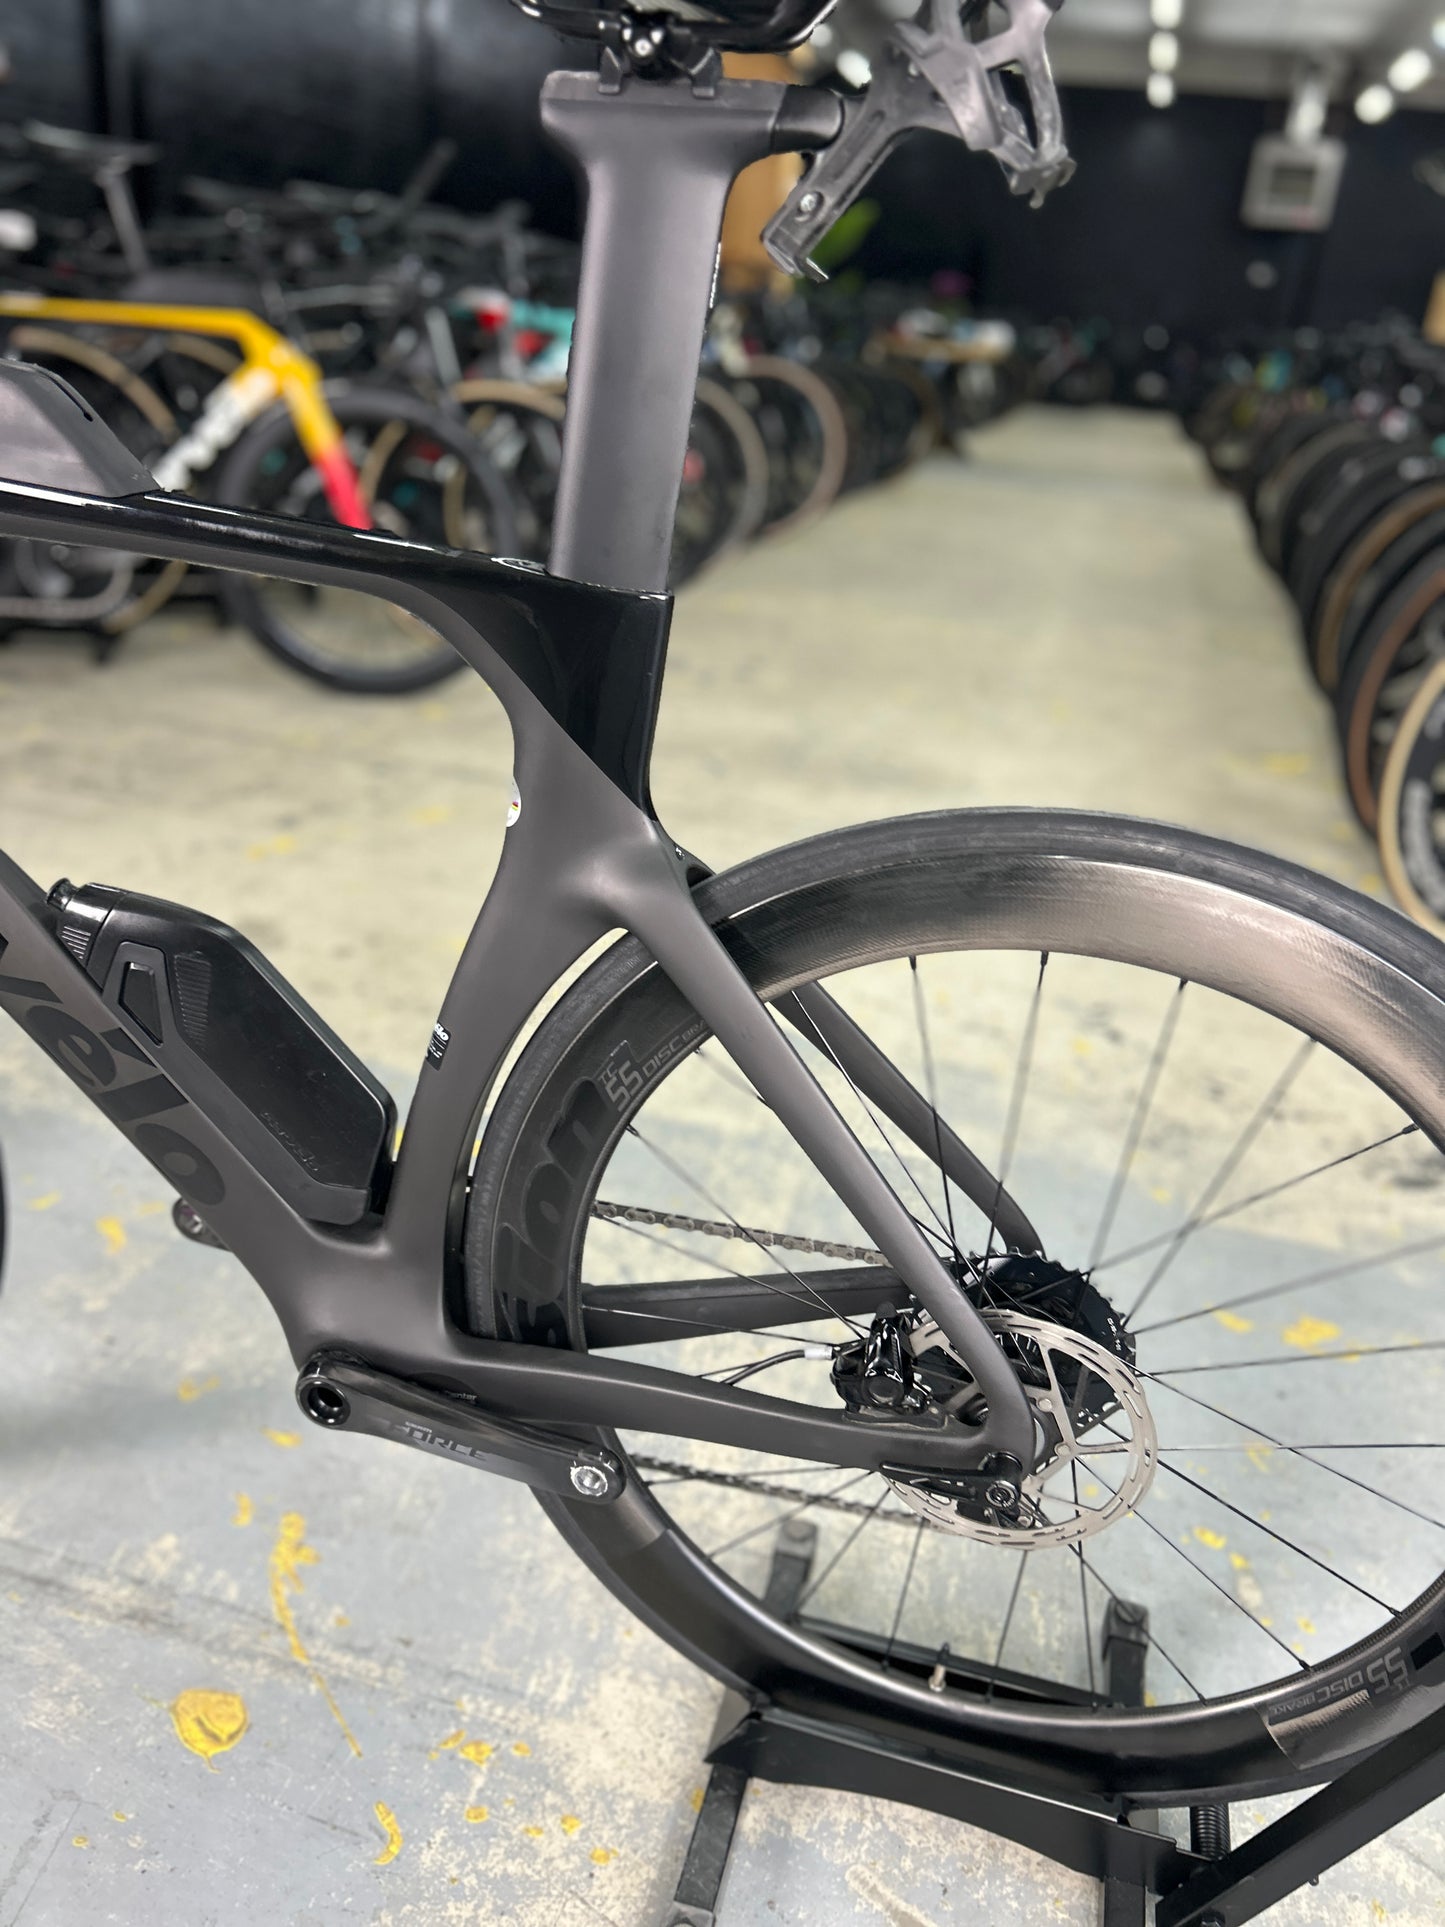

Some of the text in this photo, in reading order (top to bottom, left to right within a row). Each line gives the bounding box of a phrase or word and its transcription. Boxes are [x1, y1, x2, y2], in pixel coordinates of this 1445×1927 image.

[600, 1061, 618, 1084] TC
[605, 1060, 644, 1112] 55
[642, 1035, 683, 1078] DISC
[1316, 1669, 1364, 1703] DISC
[1366, 1646, 1408, 1695] 55
